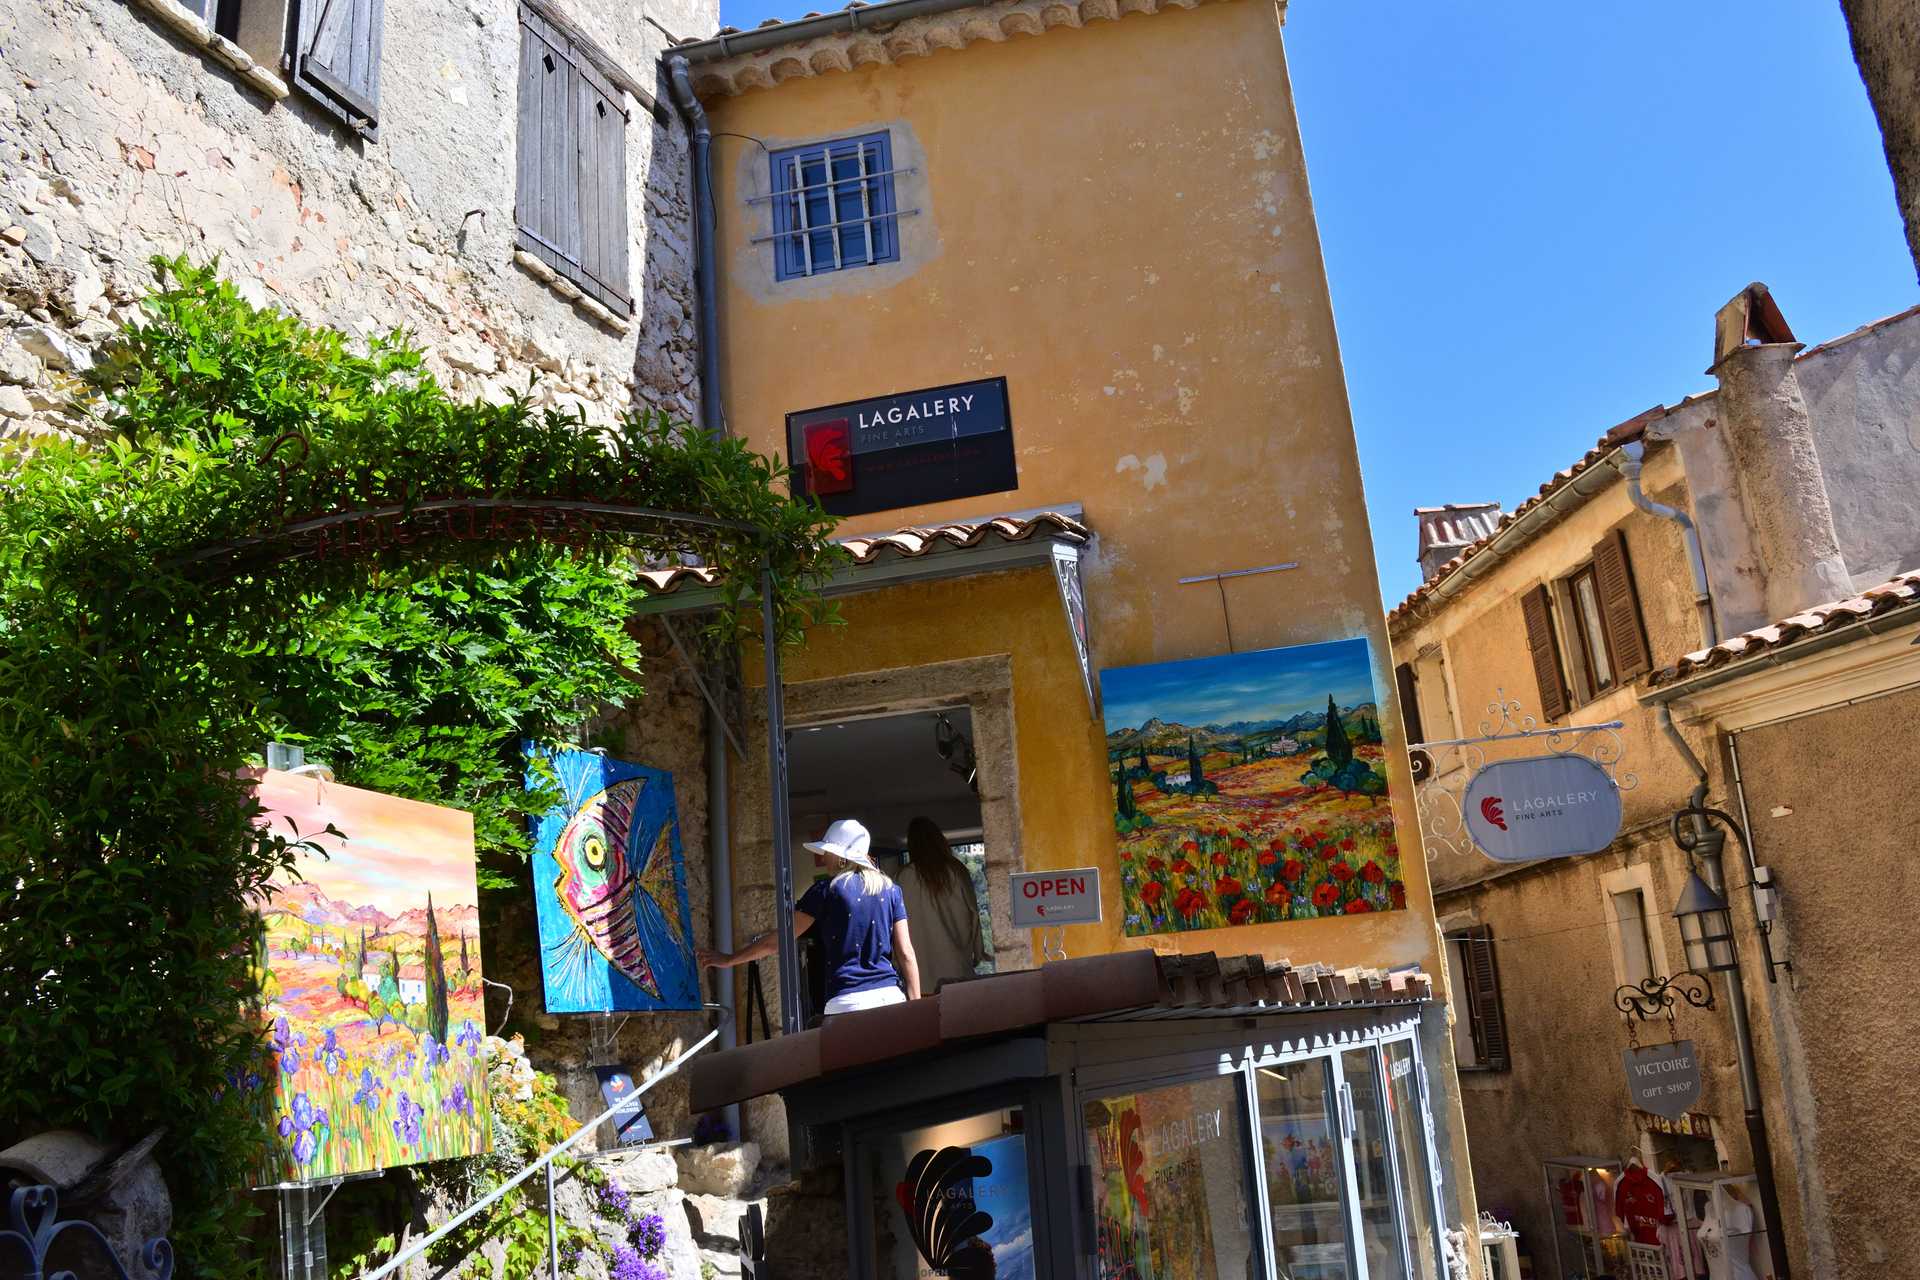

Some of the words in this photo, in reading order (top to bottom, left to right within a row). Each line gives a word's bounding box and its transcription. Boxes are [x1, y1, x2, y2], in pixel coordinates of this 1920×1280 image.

[858, 394, 975, 429] LAGALERY
[1512, 791, 1599, 812] LAGALERY
[1515, 812, 1536, 820] FINE
[1539, 809, 1563, 817] ARTS
[1023, 877, 1086, 899] OPEN
[1634, 1057, 1691, 1076] VICTOIRE
[1642, 1086, 1664, 1098] GIFT
[1667, 1081, 1692, 1094] SHOP
